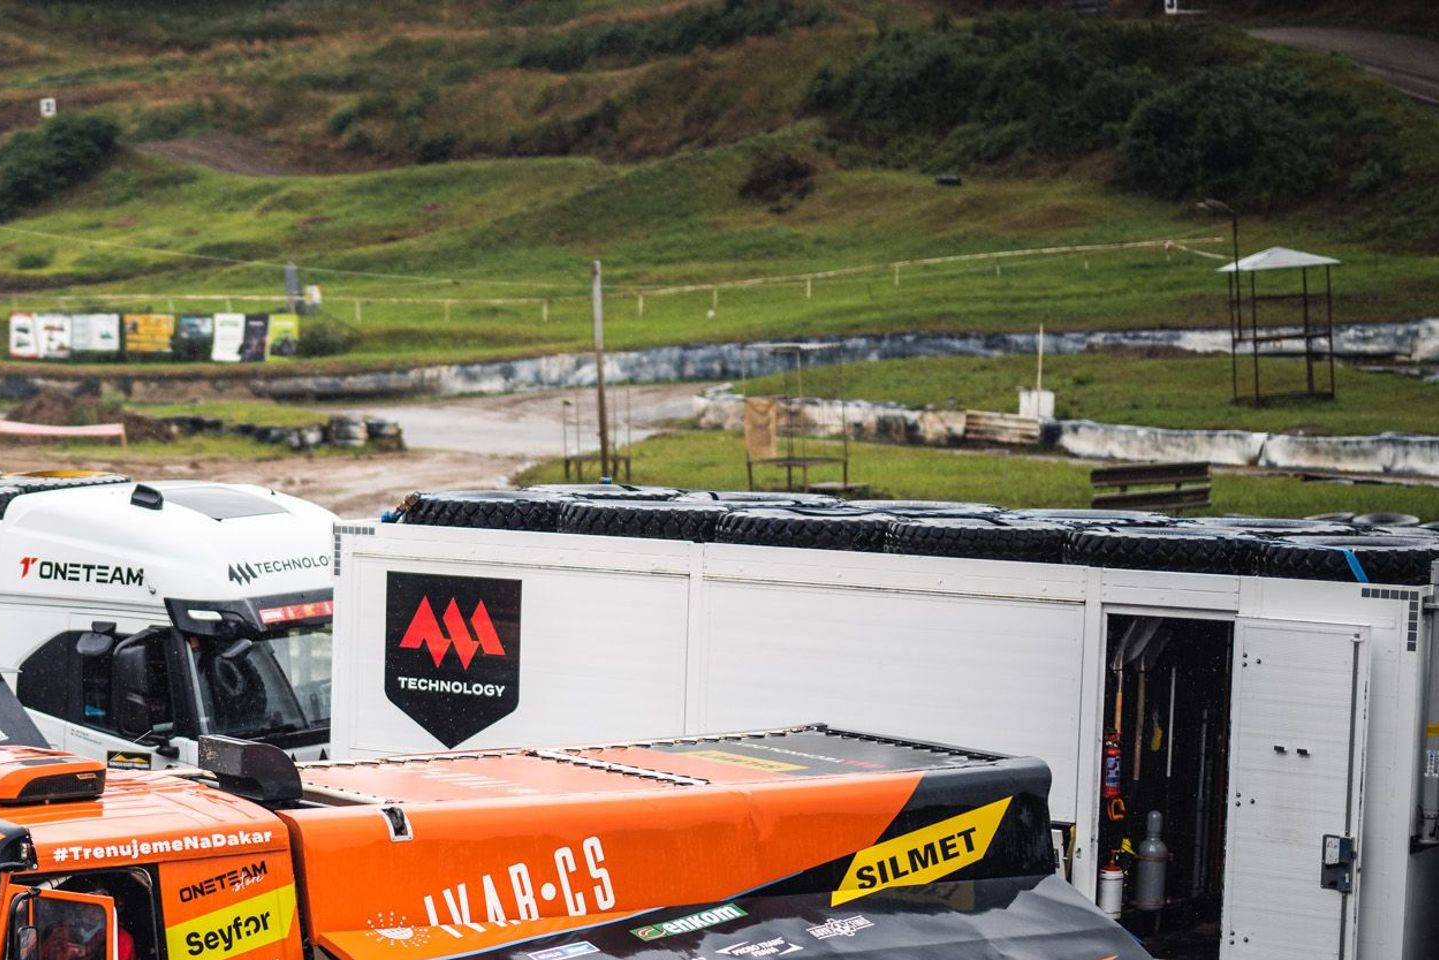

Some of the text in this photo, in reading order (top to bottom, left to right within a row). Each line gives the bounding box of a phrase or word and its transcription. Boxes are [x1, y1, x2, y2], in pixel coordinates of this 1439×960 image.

[39, 561, 143, 586] ONETEAM
[253, 555, 330, 575] TECHNOLO
[398, 676, 505, 697] TECHNOLOGY
[53, 831, 273, 862] #TrenujemeNaDakar
[856, 827, 977, 890] SILMET
[179, 861, 268, 903] ONETEAM
[185, 910, 271, 955] Seyfor
[665, 902, 740, 936] enkom
